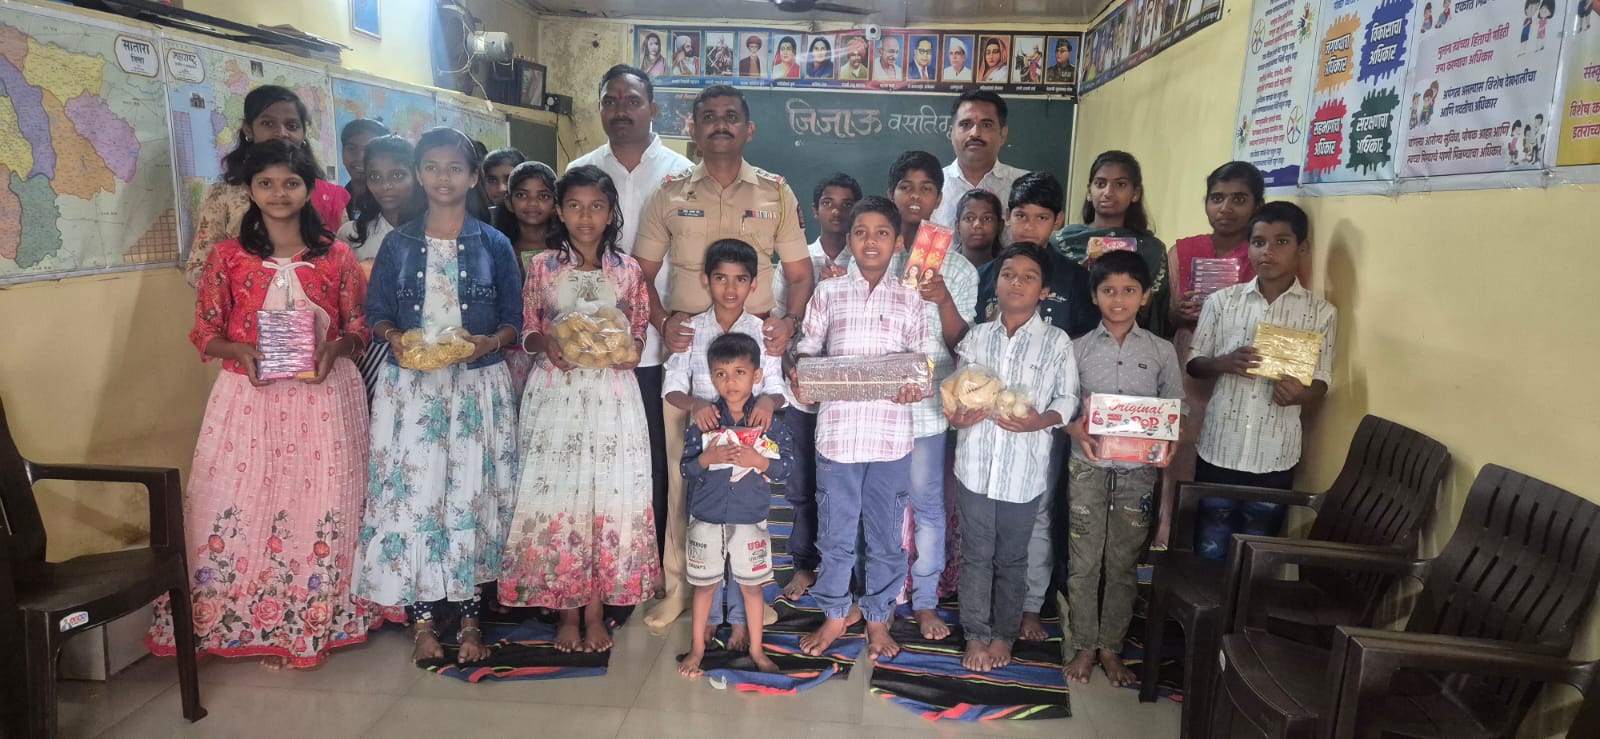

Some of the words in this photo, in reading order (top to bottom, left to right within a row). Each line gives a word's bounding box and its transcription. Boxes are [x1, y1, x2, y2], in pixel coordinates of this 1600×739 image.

[1371, 19, 1402, 42] विकासाचा
[121, 40, 150, 55] सातारा
[1369, 44, 1398, 65] अधिकार
[1468, 49, 1494, 66] अधिकार
[1474, 96, 1499, 112] अधिकार
[1570, 101, 1590, 118] विशेष
[785, 98, 882, 138] जिजाऊ
[1355, 135, 1384, 155] अधिकार
[748, 540, 767, 551] USA
